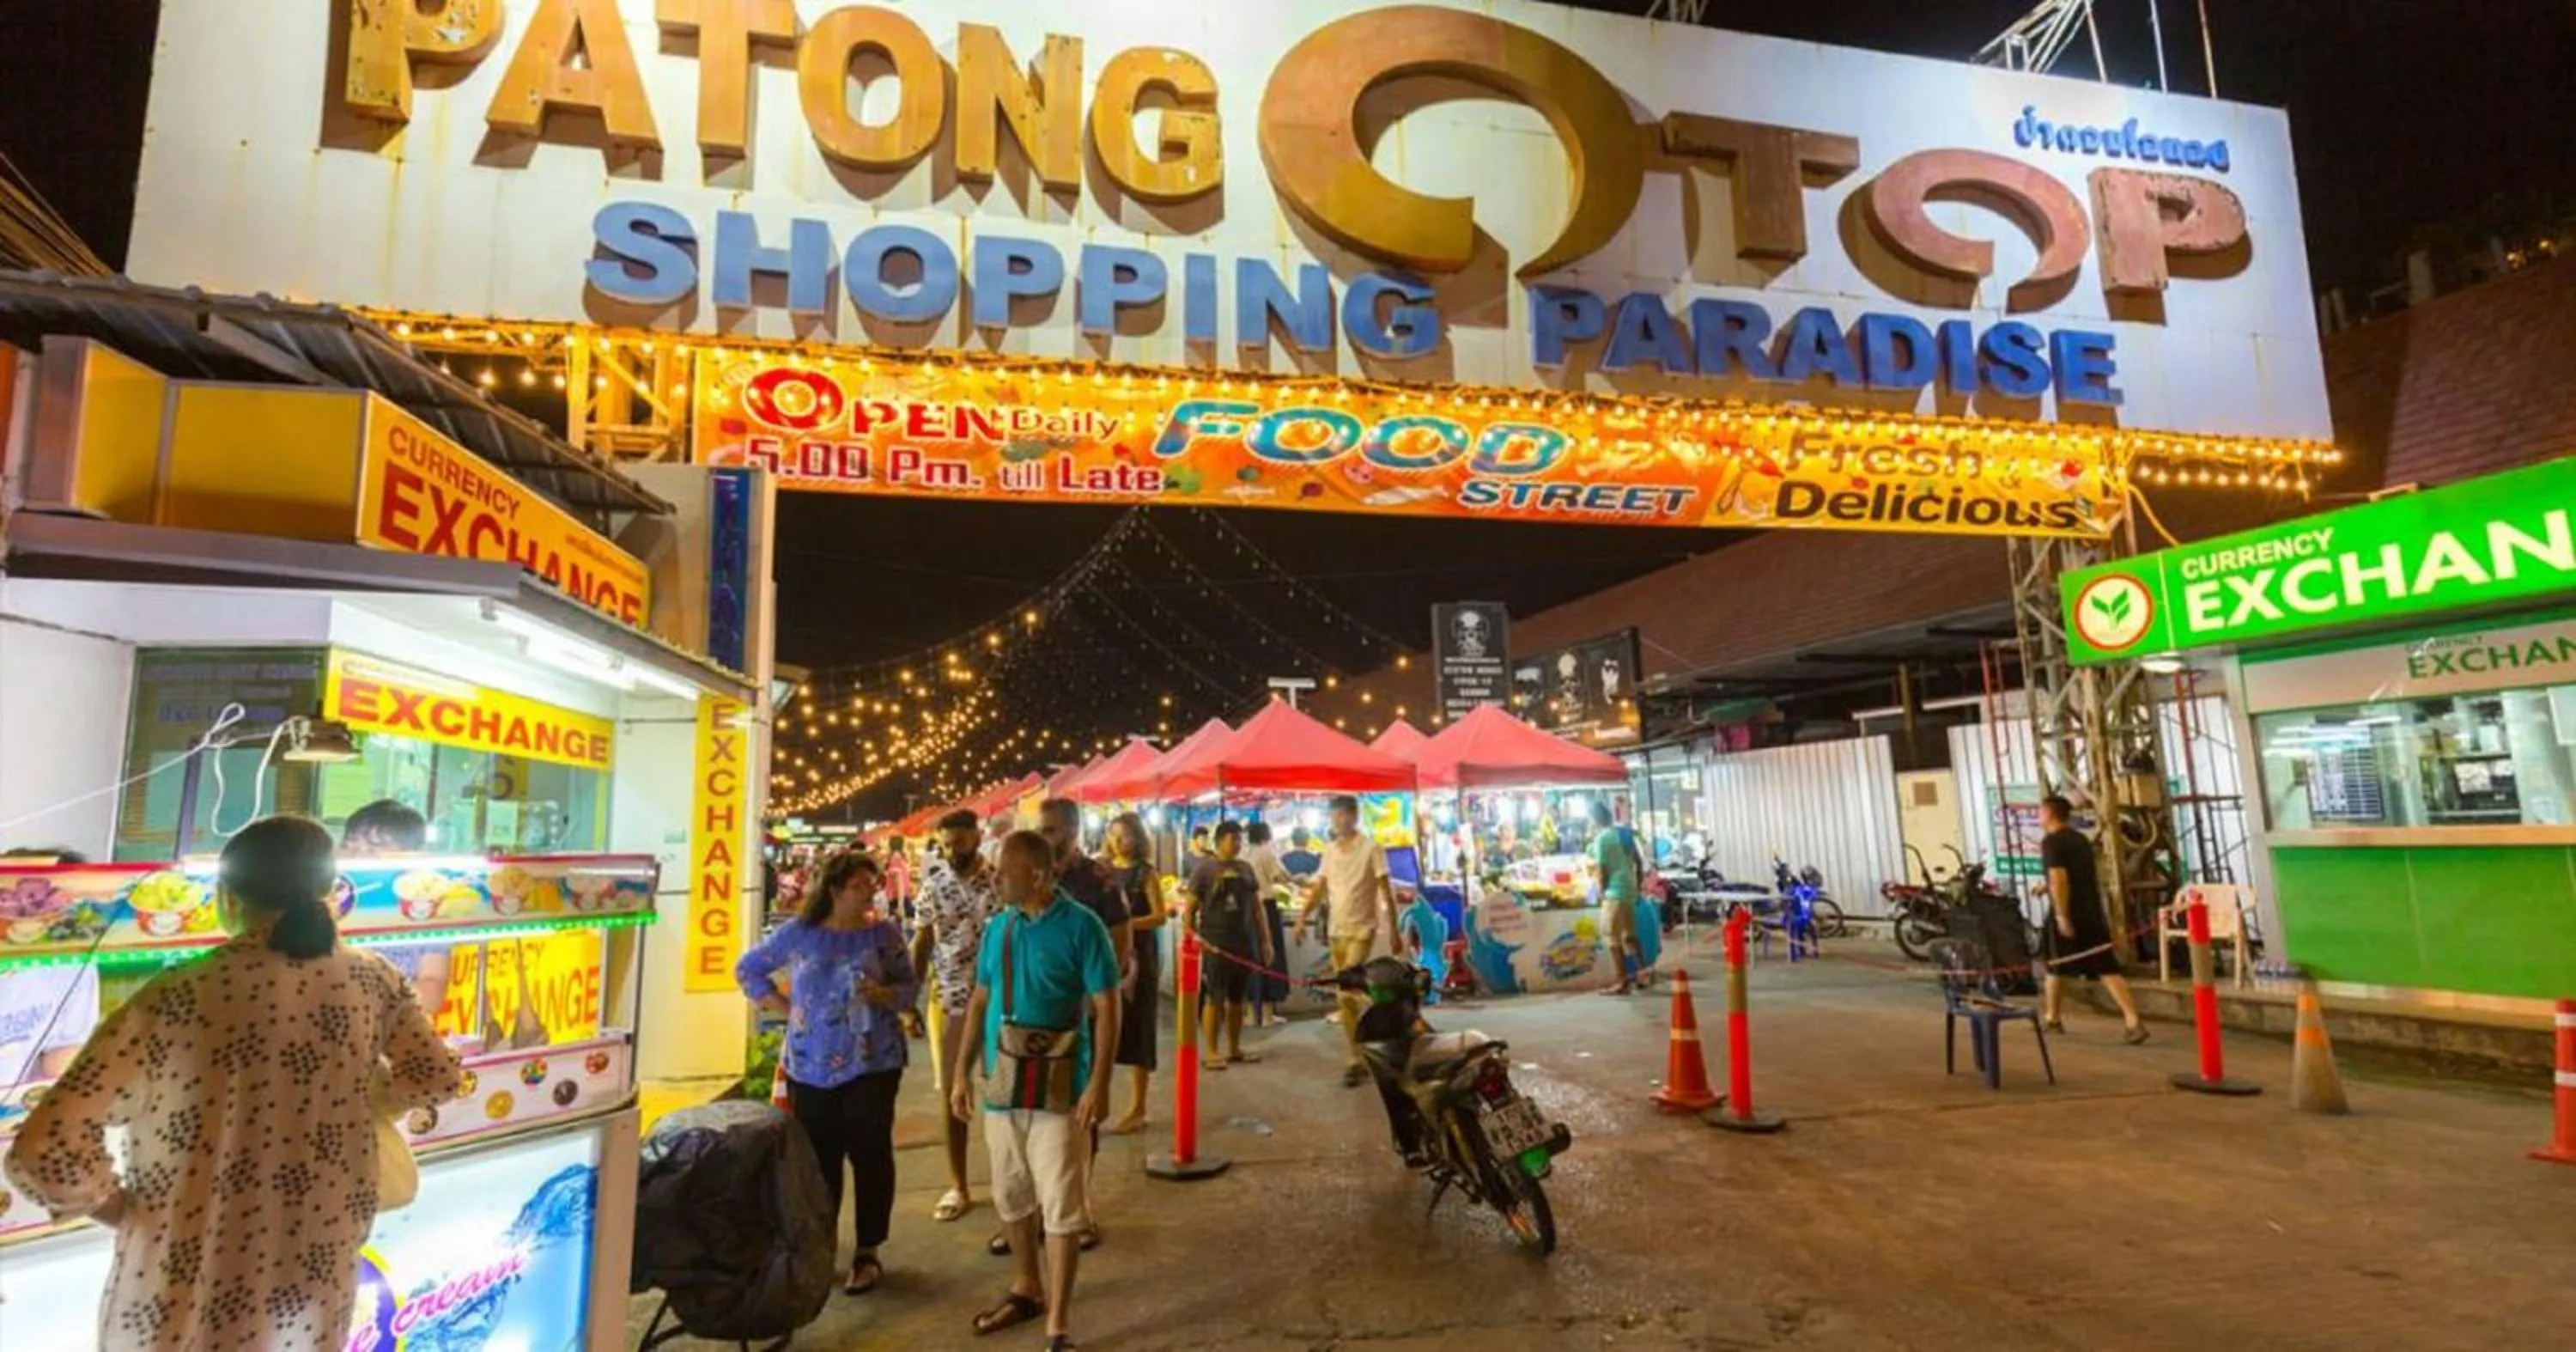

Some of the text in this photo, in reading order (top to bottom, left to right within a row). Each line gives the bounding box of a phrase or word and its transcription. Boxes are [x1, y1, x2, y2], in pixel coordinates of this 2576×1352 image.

[346, 0, 1223, 202] PATONG
[585, 201, 2123, 405] SHOPPING PARADISE
[744, 367, 1120, 442] OPEN Daily
[1154, 400, 1568, 474] FOOD
[387, 425, 520, 520] CURRENCY
[890, 449, 982, 487] Pm.
[1002, 466, 1043, 490] till
[1060, 457, 1163, 492] Late
[1784, 432, 1982, 478] Fresh
[1461, 481, 1696, 513] STREET
[1775, 480, 2079, 528] Delicious
[2181, 527, 2334, 579] CURRENCY
[2184, 510, 2576, 632] EXCHAN
[338, 677, 609, 763] EXCHANGE
[699, 702, 737, 976] EXCHANGE
